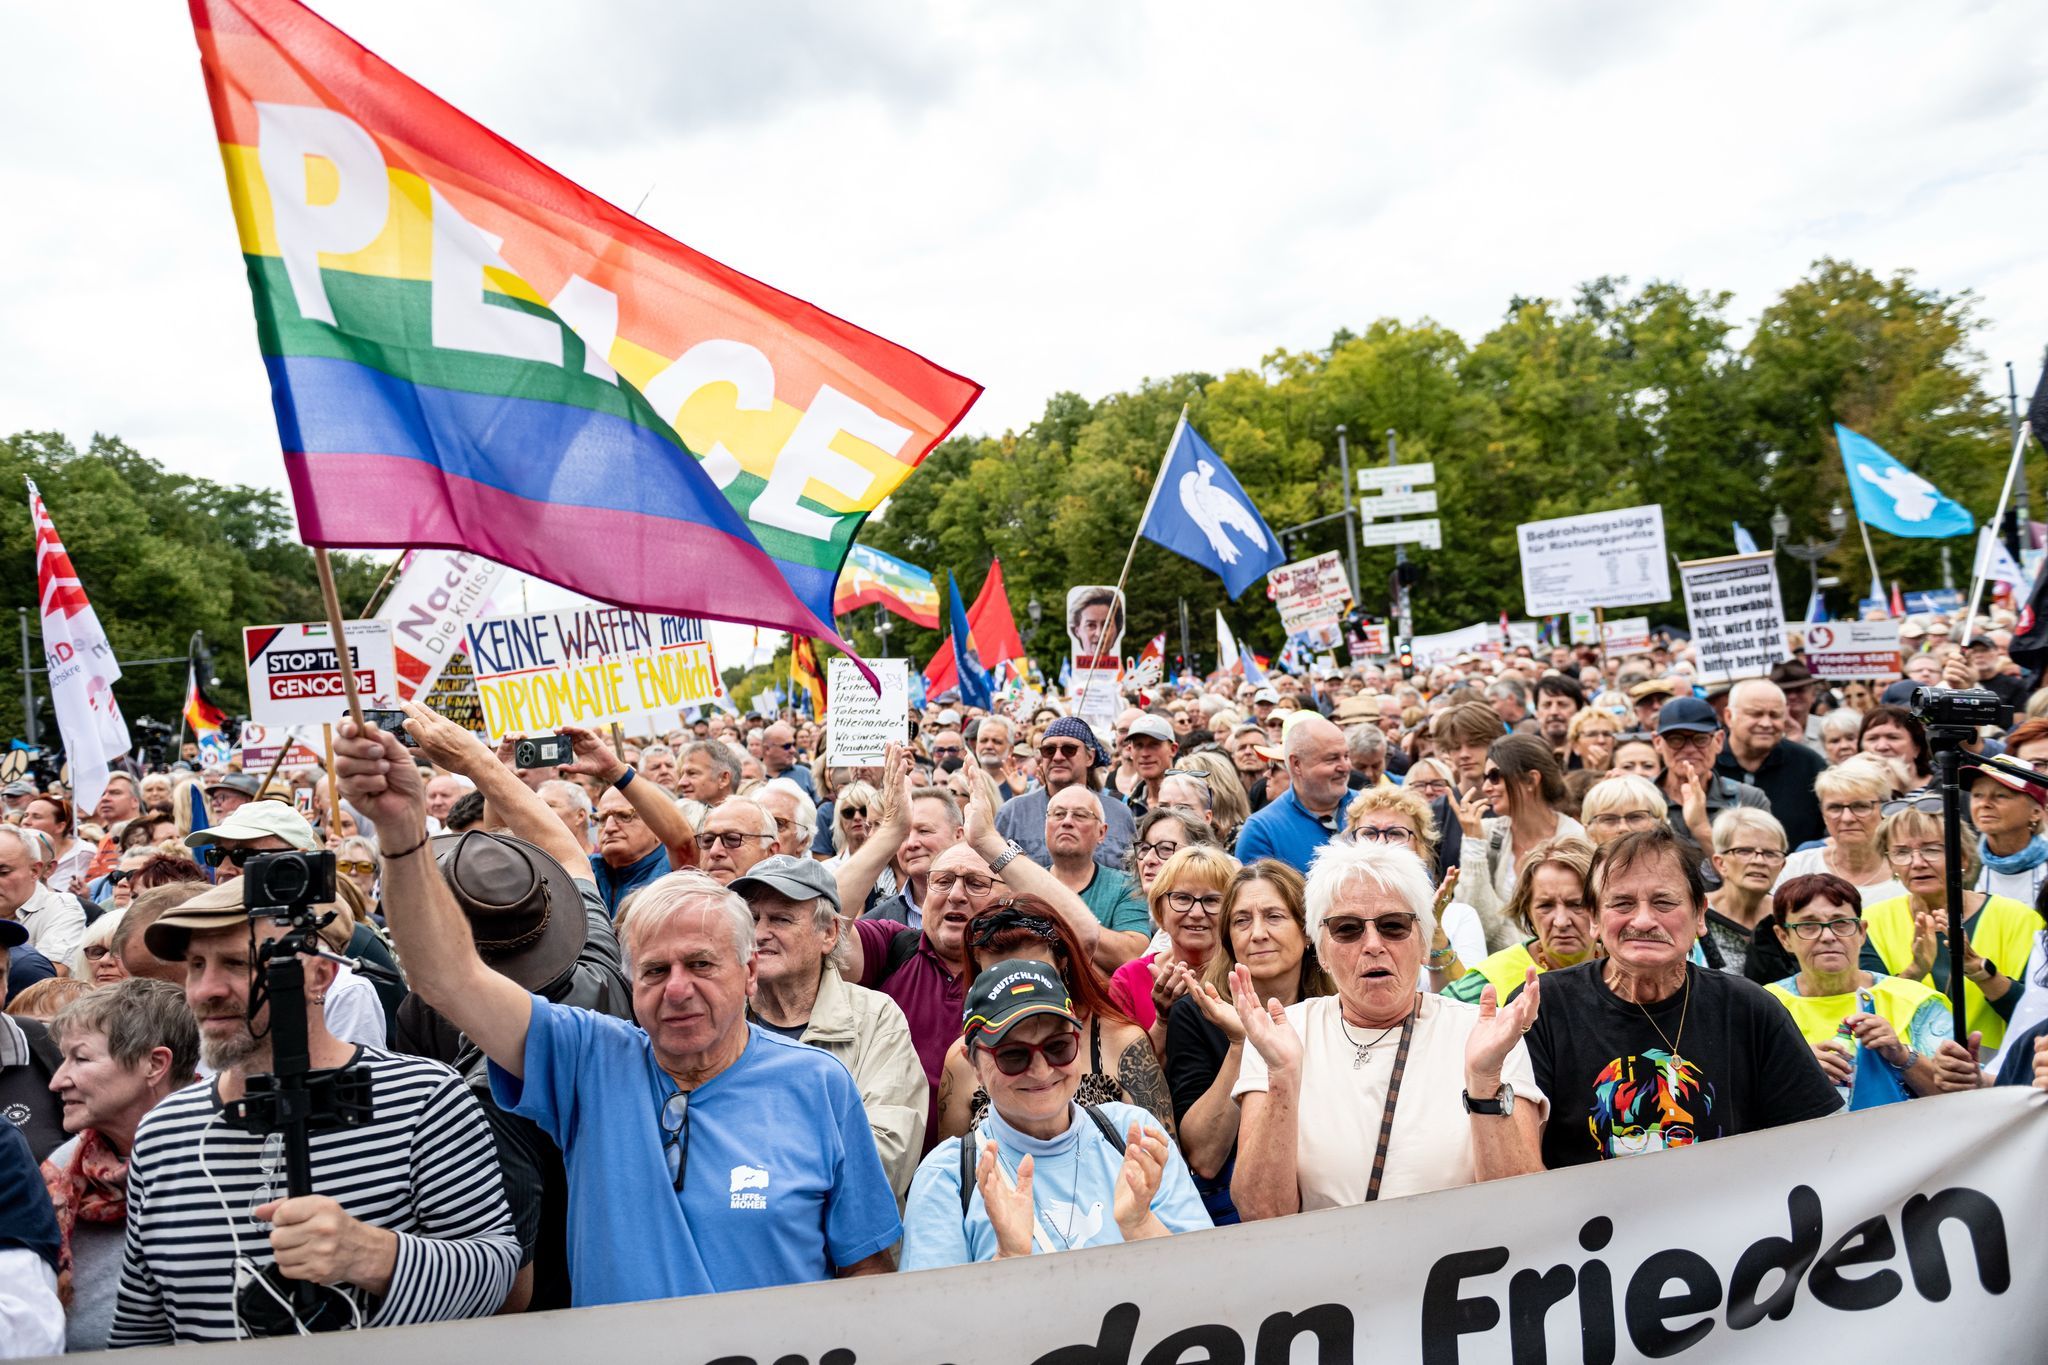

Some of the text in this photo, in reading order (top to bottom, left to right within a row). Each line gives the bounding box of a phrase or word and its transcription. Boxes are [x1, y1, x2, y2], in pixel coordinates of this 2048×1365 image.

[1724, 619, 1752, 634] wird
[1755, 617, 1779, 631] das
[426, 622, 457, 655] Die
[467, 613, 557, 674] KEINE
[554, 608, 652, 661] WAFFEN
[269, 651, 317, 673] STOP
[1077, 657, 1117, 668] Urula
[1811, 652, 1895, 665] Frieden statt
[479, 662, 630, 740] DIPLOMATIE
[832, 705, 881, 715] Toleranz
[987, 971, 1053, 1001] DEUTSCHLAND
[730, 1200, 767, 1209] MOHER
[1421, 1183, 2012, 1365] Frieden
